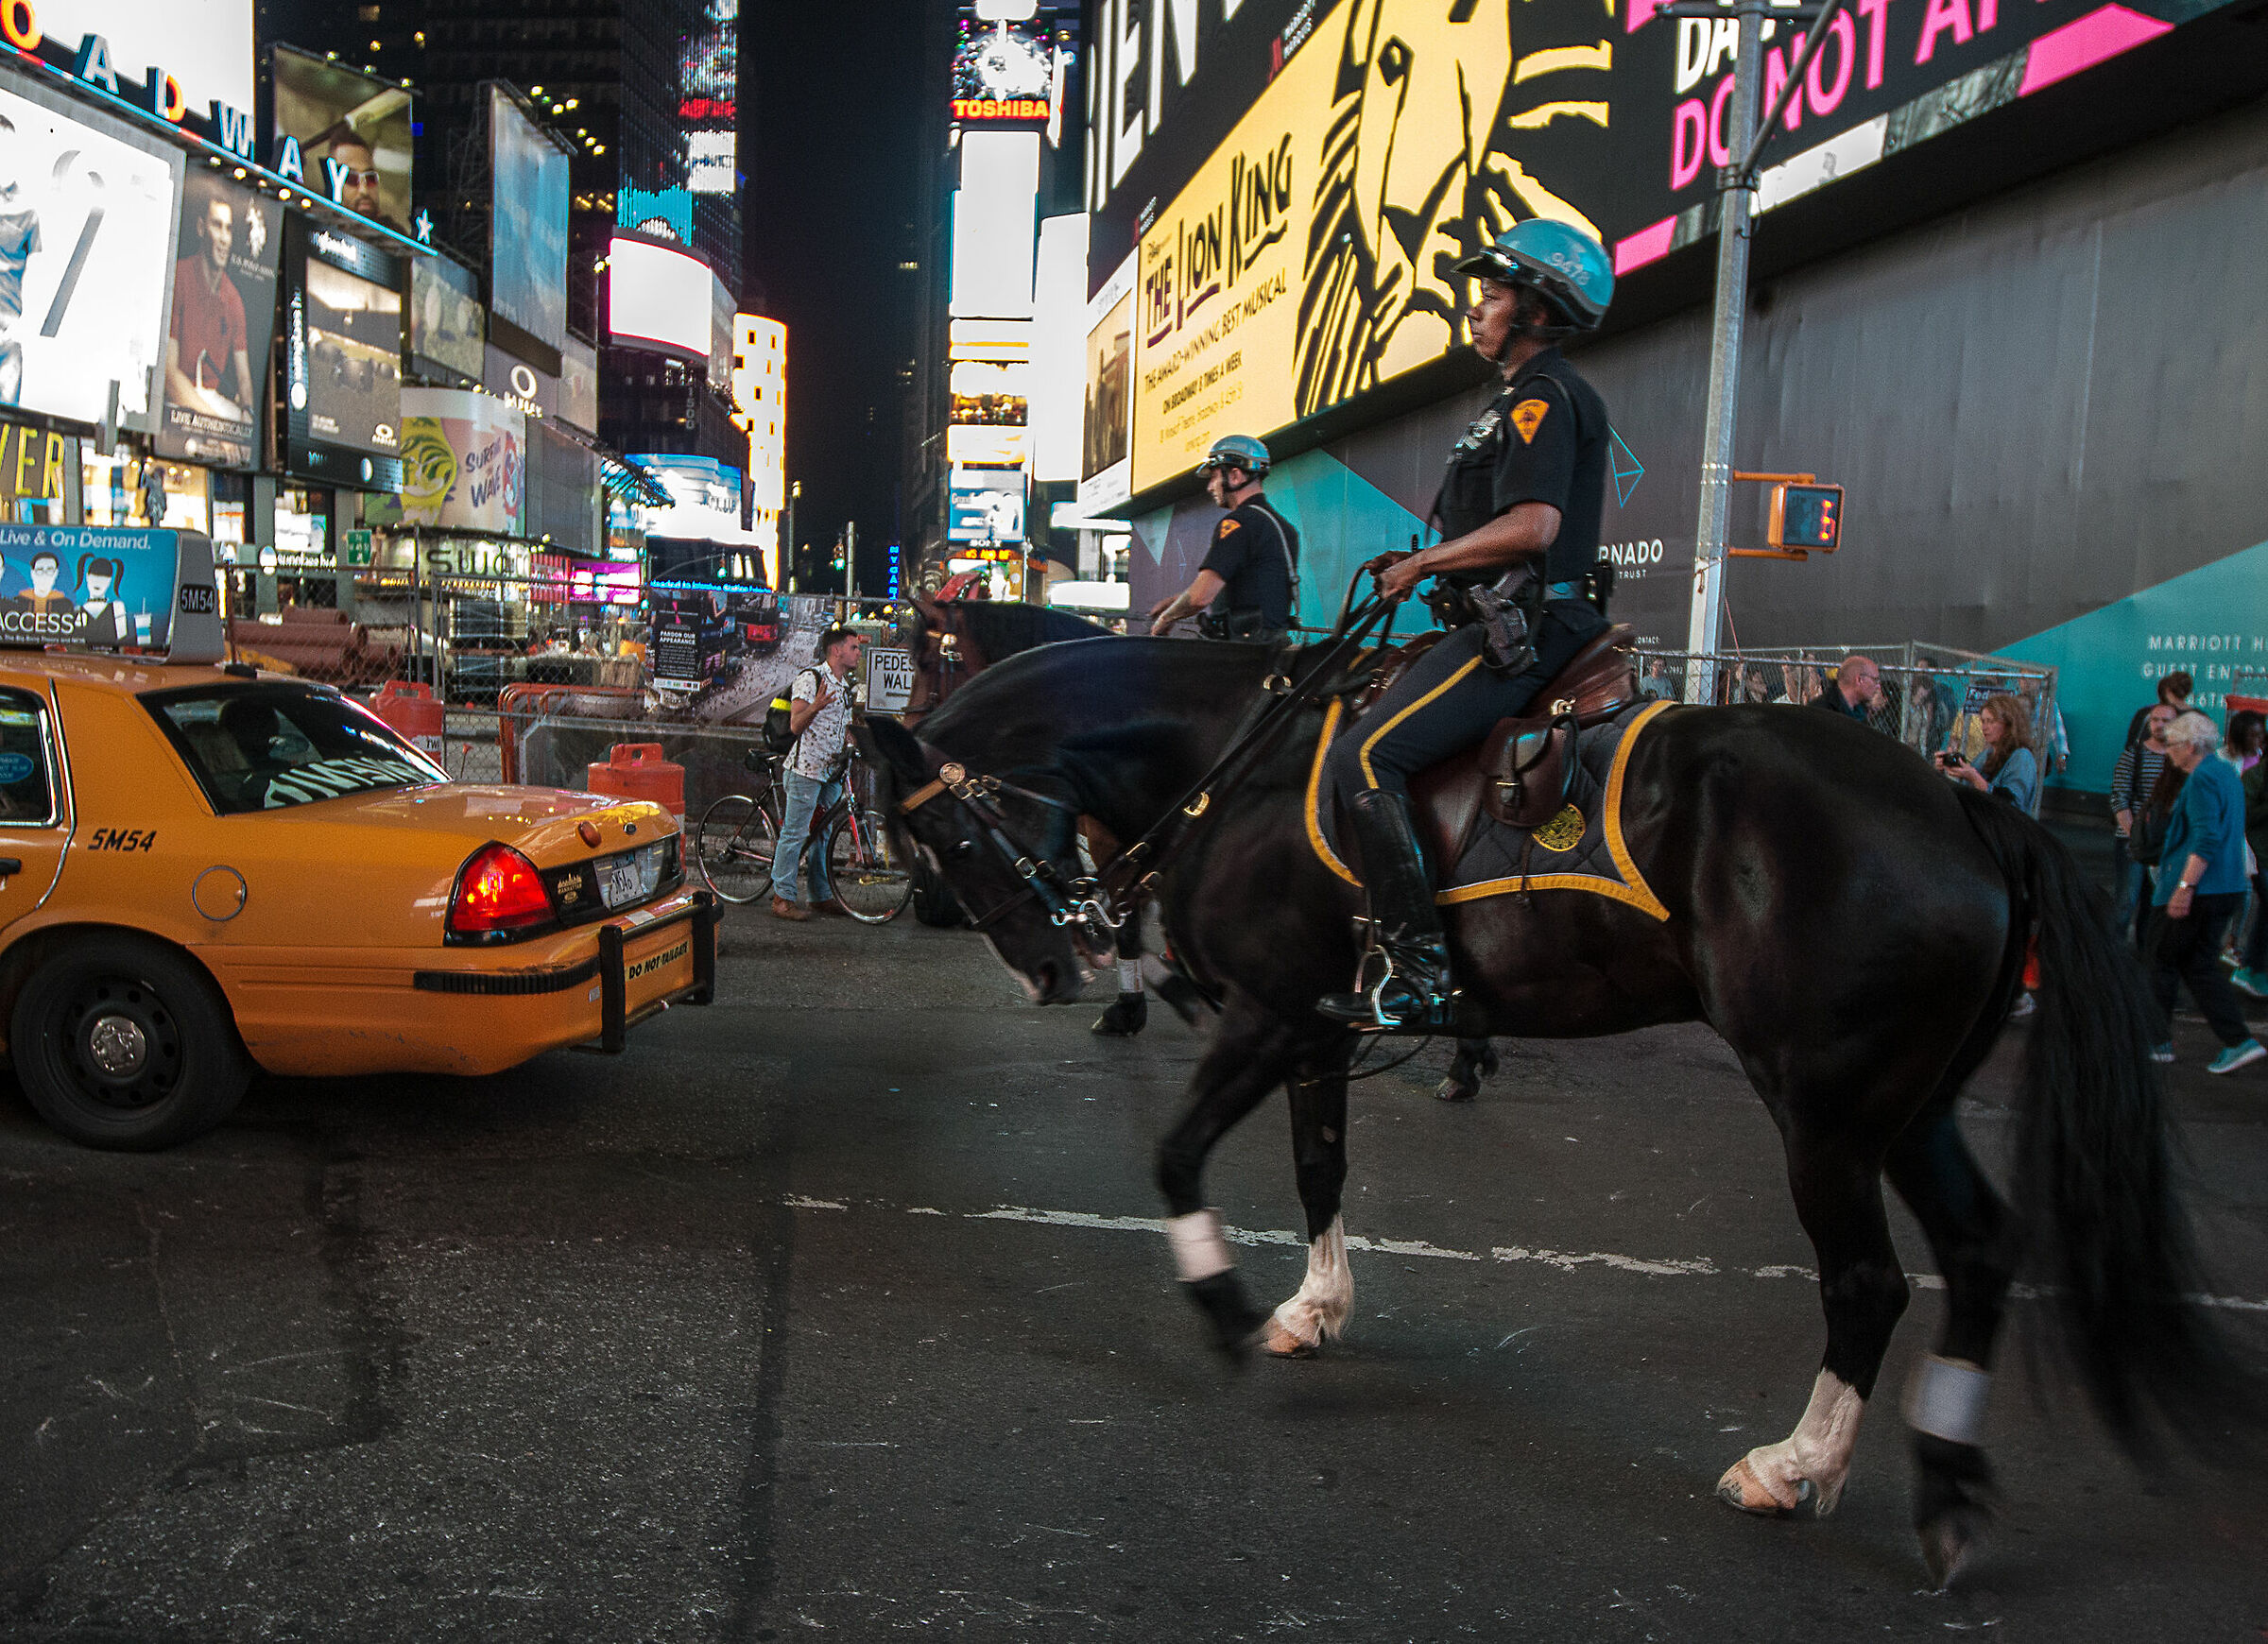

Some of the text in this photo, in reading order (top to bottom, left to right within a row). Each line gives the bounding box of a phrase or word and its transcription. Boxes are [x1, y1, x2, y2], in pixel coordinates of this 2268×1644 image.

[953, 99, 1049, 117] TOSHIBA
[1145, 131, 1293, 334] THE LION KING
[1243, 267, 1286, 324] MUSICAL
[471, 464, 502, 507] WAVE
[0, 529, 152, 550] Live & On Demand.
[1619, 569, 1647, 579] TRUST
[180, 588, 215, 612] 5M54
[2148, 634, 2242, 651] MARRIOTT
[628, 940, 689, 980] DO NOT TAILGATE
